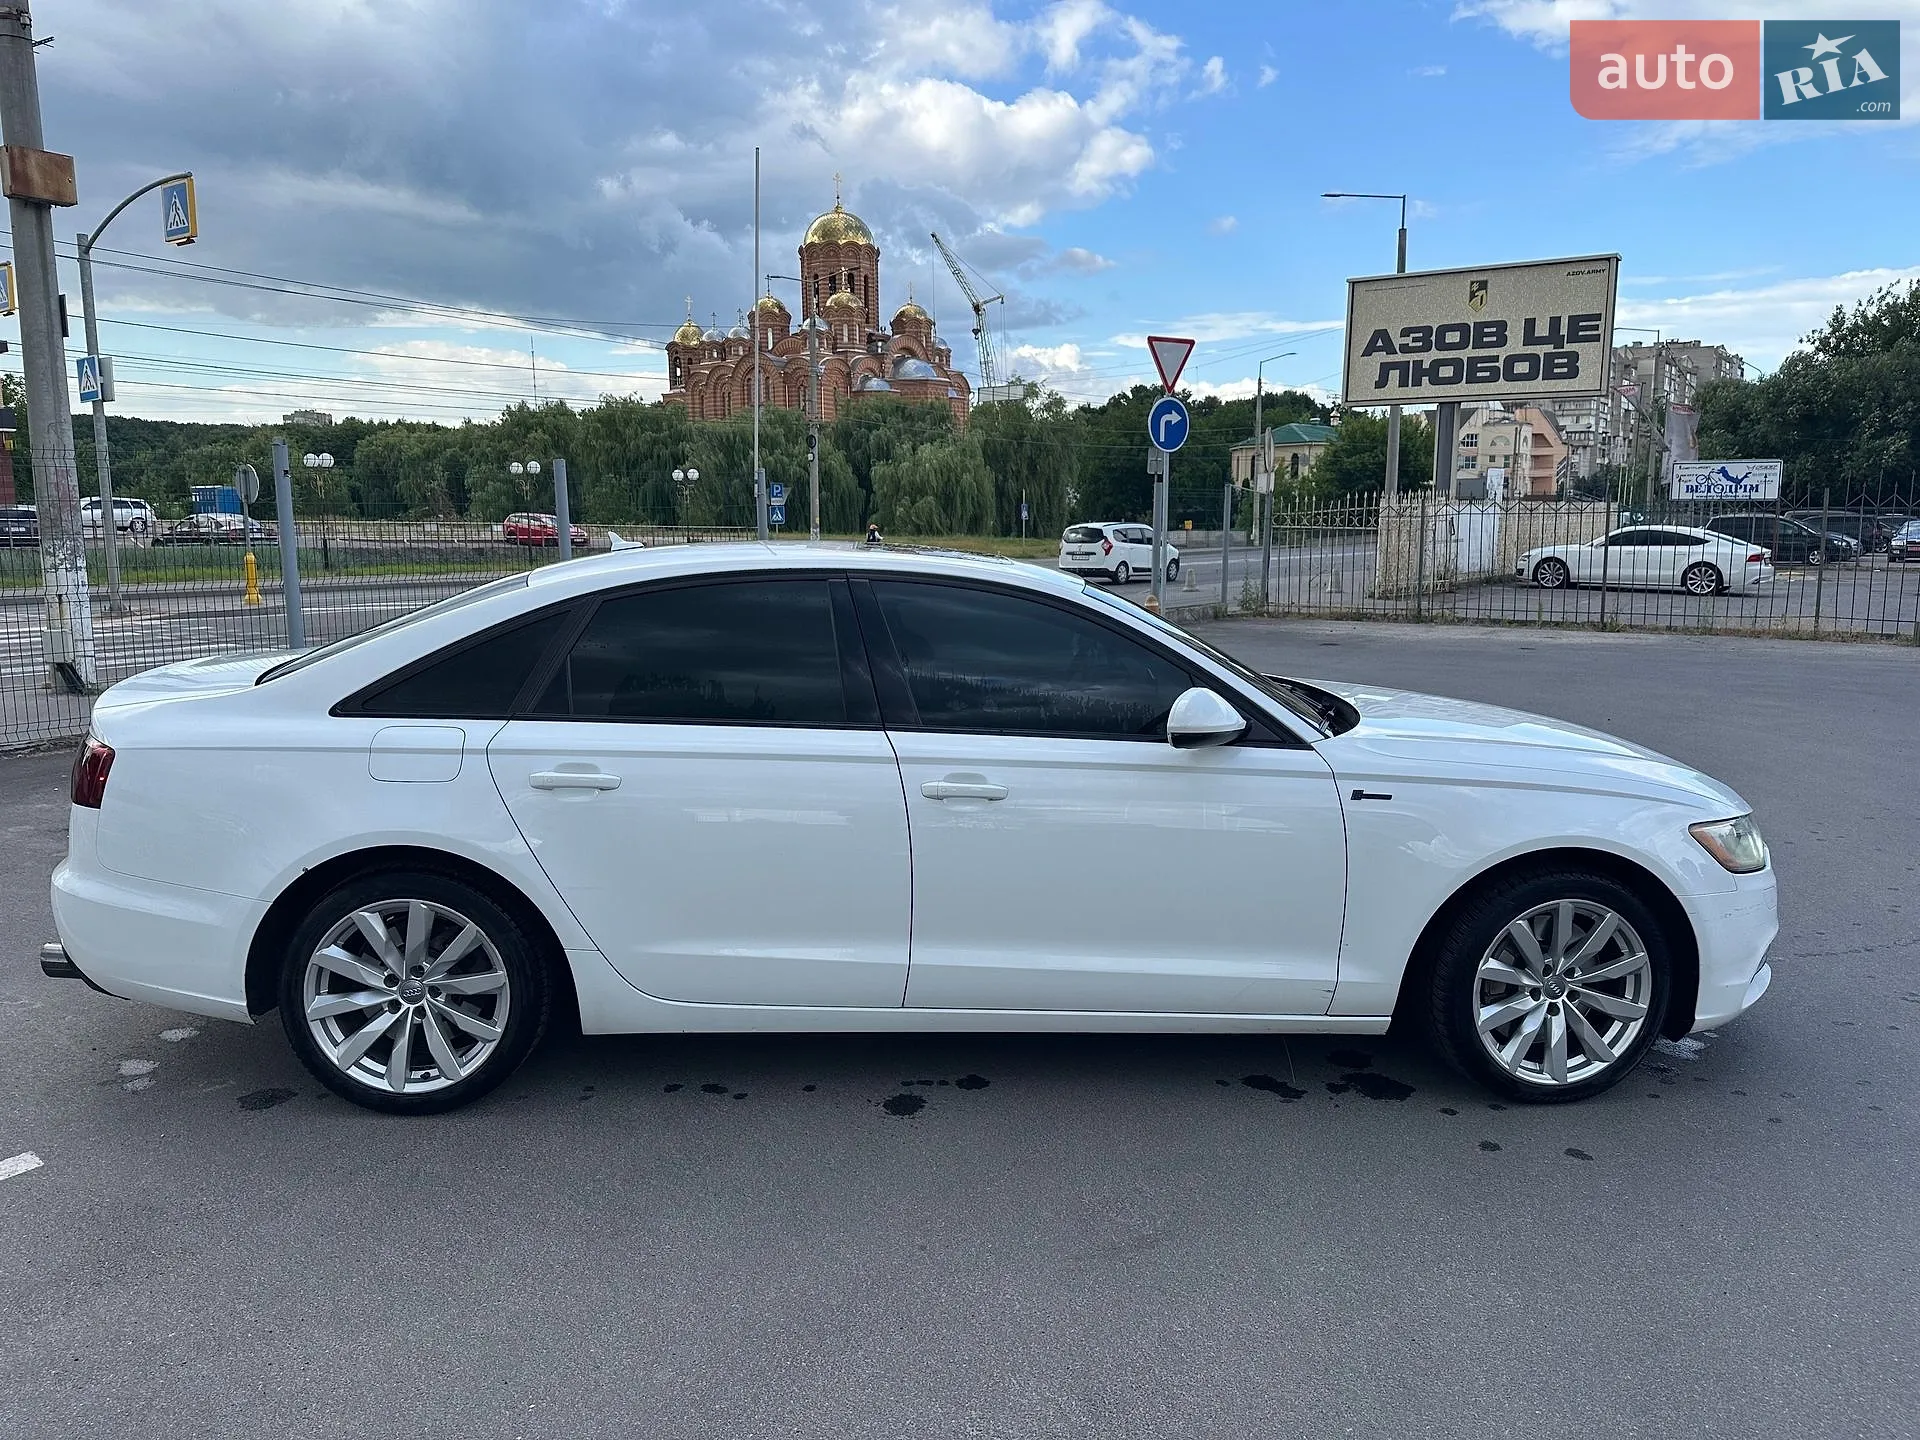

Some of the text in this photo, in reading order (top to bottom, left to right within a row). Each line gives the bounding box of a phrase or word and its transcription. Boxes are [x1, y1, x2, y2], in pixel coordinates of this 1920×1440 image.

[1361, 313, 1602, 357] АЗОВ ЦЕ
[1374, 351, 1580, 389] ЛЮБОВ
